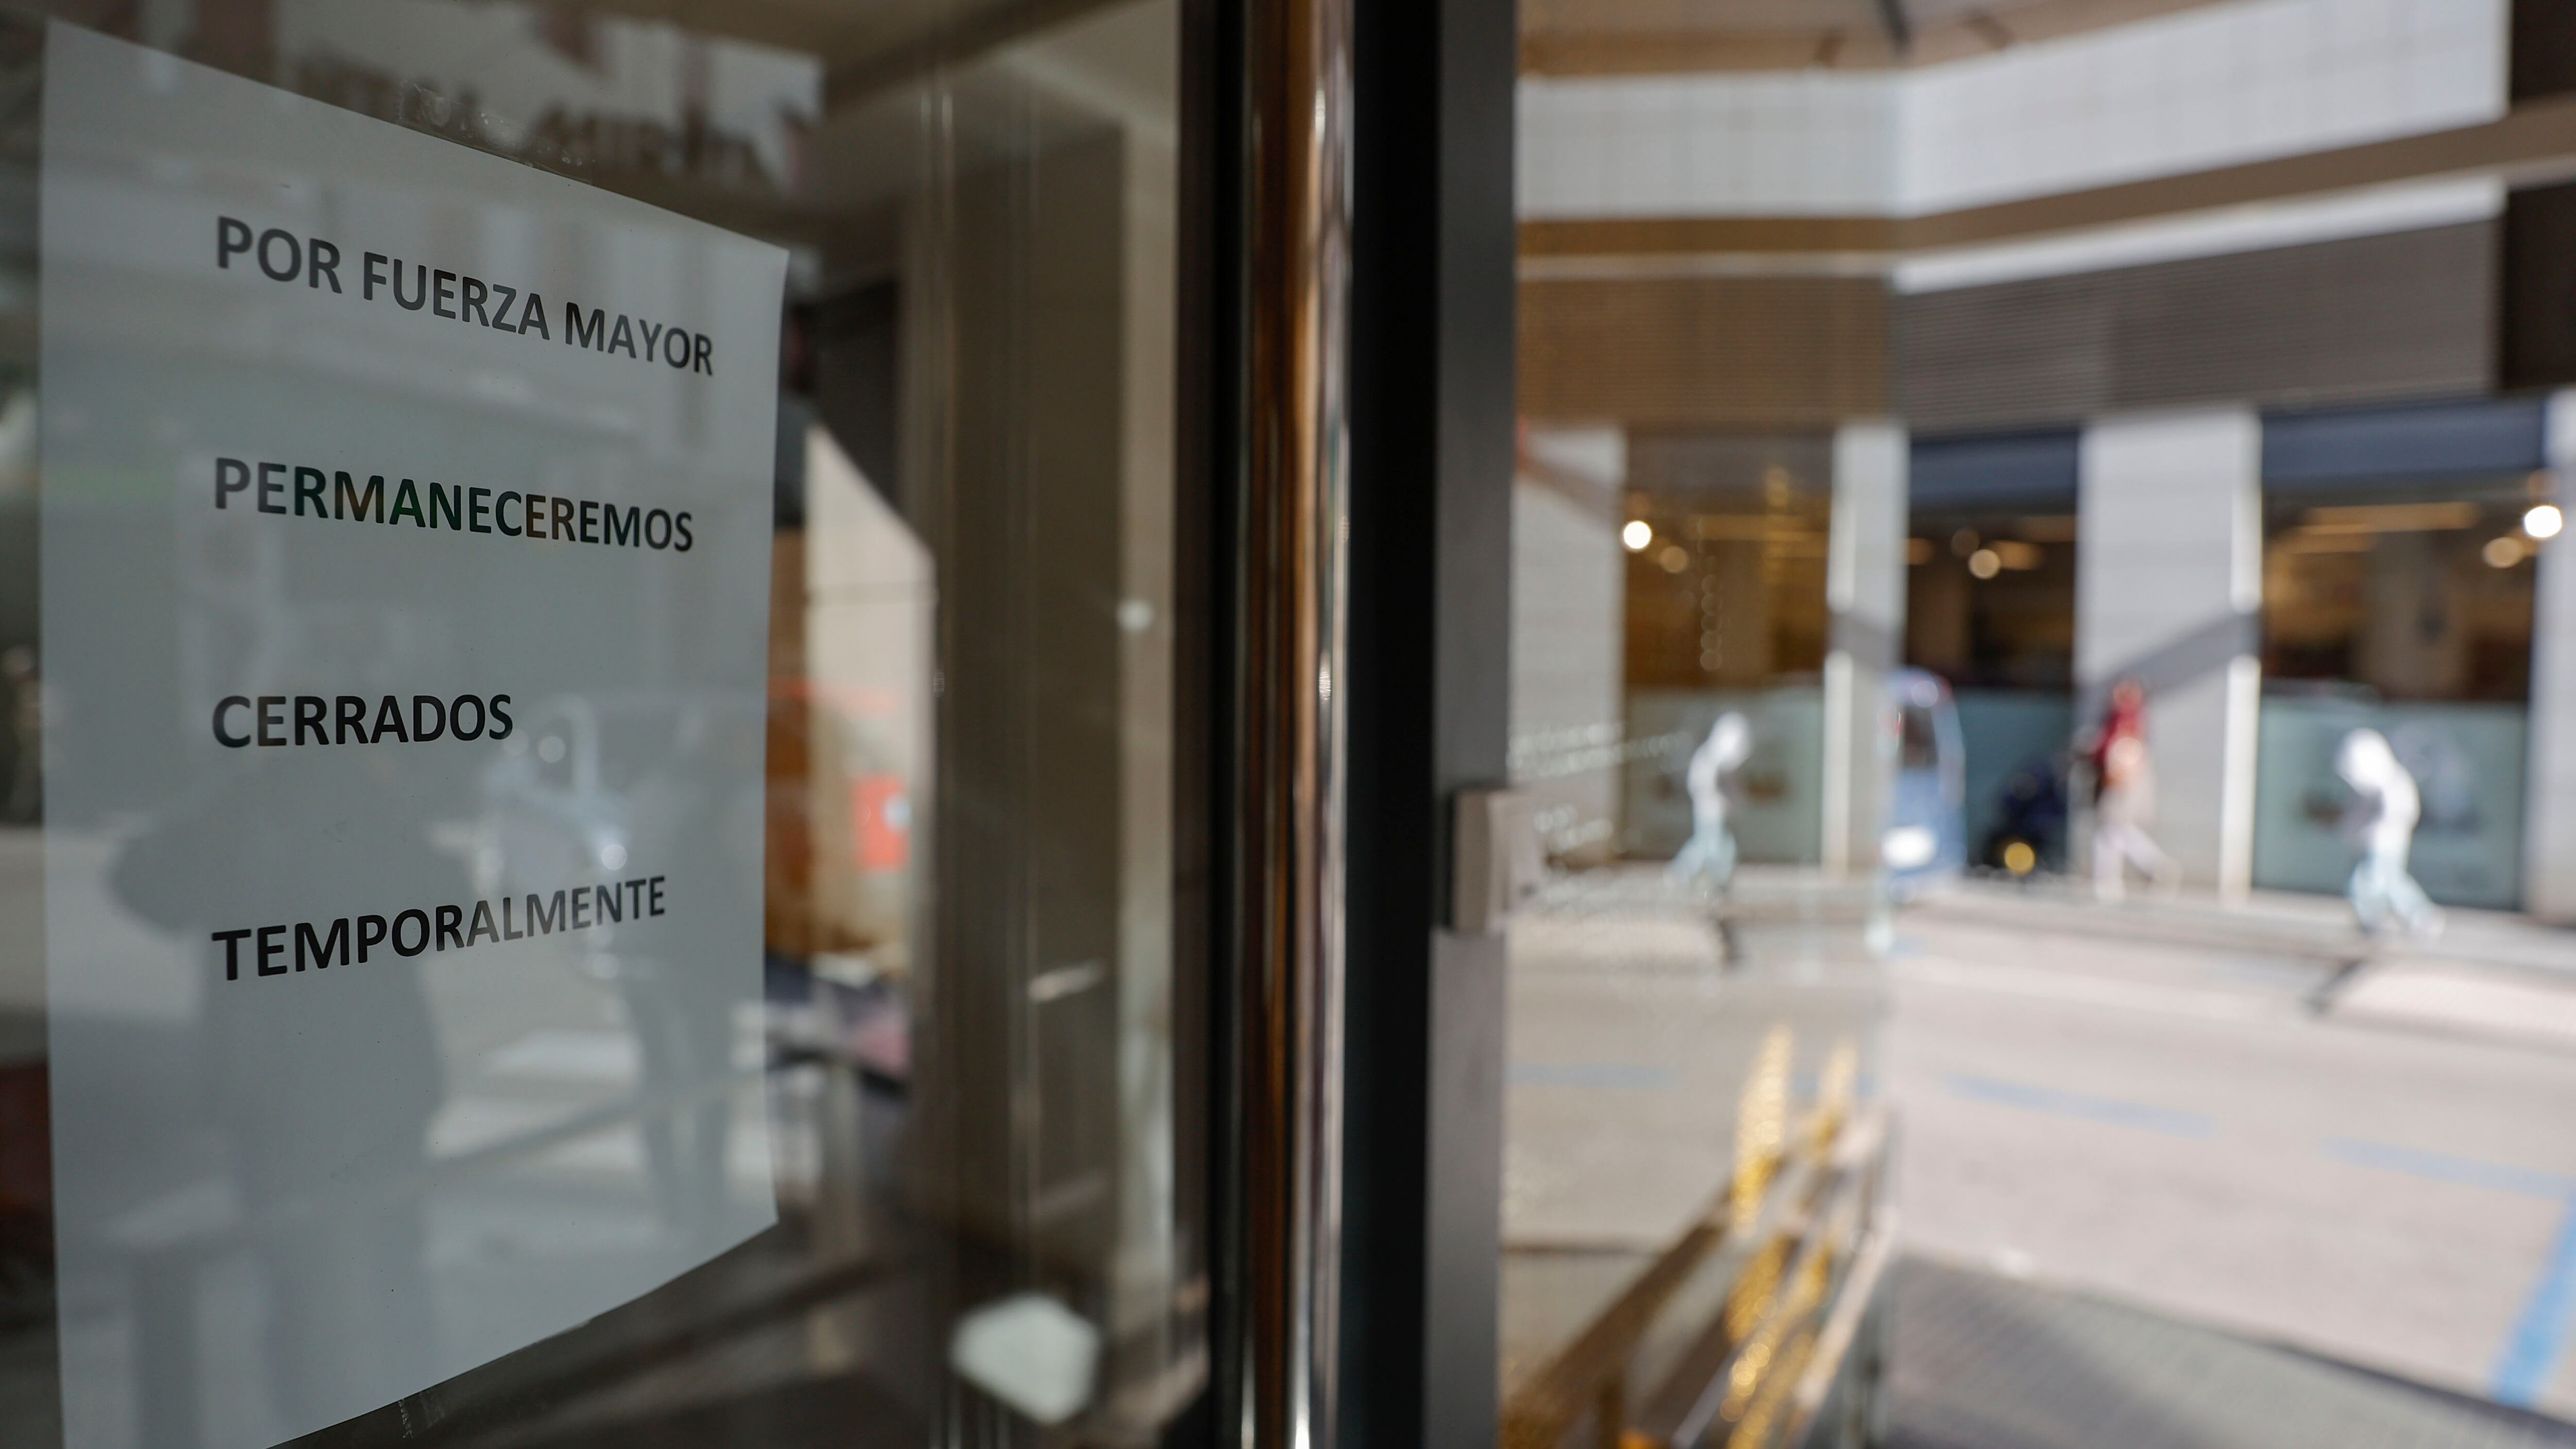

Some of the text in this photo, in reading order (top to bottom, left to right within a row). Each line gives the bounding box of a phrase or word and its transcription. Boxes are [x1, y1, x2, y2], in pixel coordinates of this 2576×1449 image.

[217, 215, 714, 377] POR FUERZA MAYOR
[214, 456, 694, 554] PERMANECEREMOS
[212, 693, 514, 749] CERRADOS
[210, 874, 666, 981] TEMPORALMENTE
